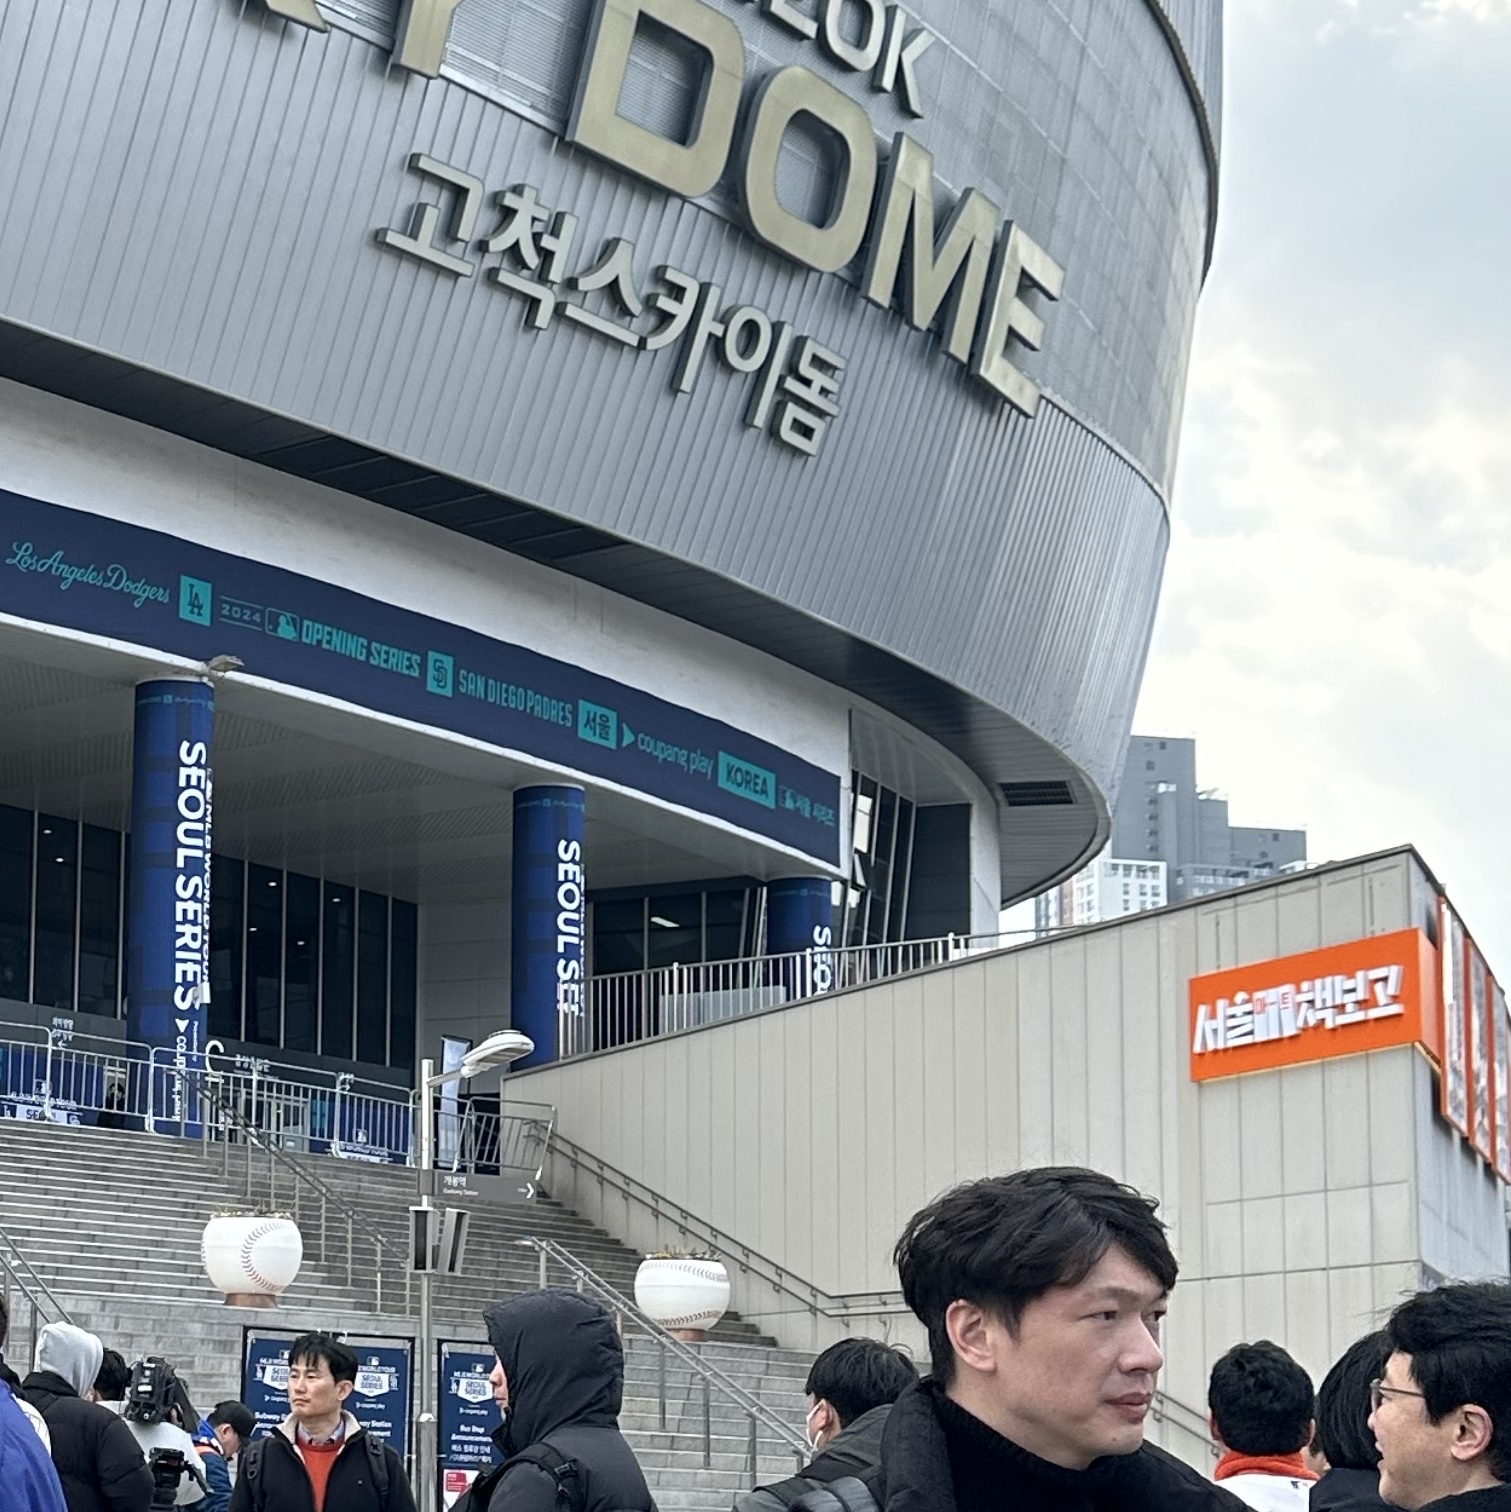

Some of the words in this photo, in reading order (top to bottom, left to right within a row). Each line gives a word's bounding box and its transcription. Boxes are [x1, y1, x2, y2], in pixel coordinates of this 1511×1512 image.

[565, 0, 1065, 419] DOME
[376, 151, 848, 458] 고척스카이돔
[221, 602, 263, 624] 2024
[301, 619, 368, 662] OPENING
[369, 641, 422, 678] SERIES
[458, 668, 486, 700] SAN
[487, 677, 526, 710] DIEGO
[525, 690, 573, 728] PADRES
[583, 709, 612, 742] 서울
[637, 732, 690, 774] coupang
[689, 749, 715, 781] play
[725, 761, 769, 798] KOREA
[176, 738, 208, 869] SEOUL
[173, 874, 205, 1011] SERIES
[556, 838, 582, 954] SEOUL
